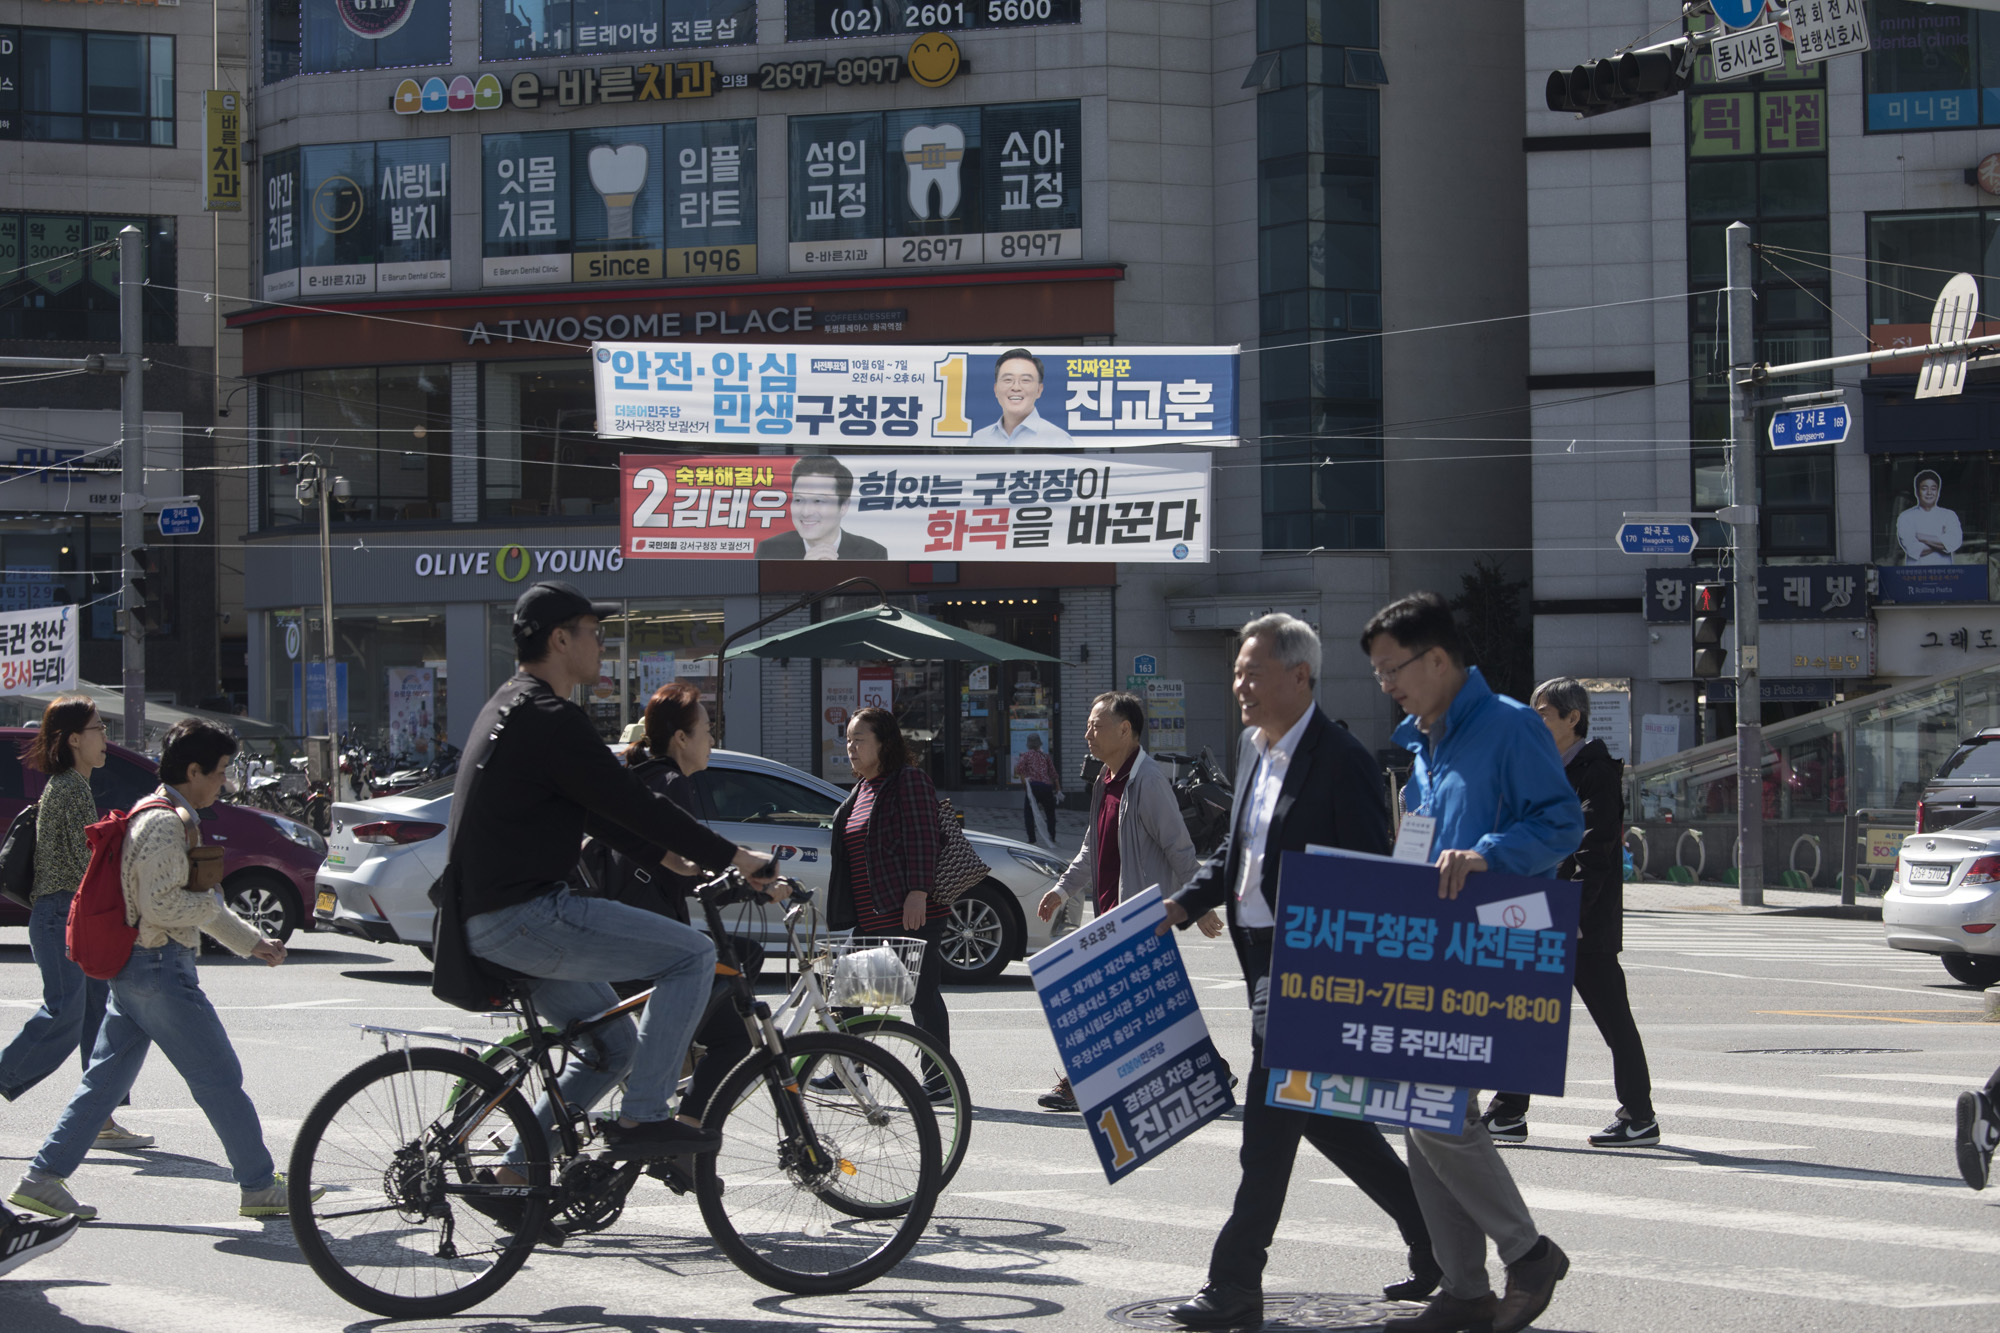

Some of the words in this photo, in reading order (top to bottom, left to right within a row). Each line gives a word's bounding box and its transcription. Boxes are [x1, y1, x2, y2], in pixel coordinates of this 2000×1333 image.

[529, 30, 563, 52] 1:1
[579, 22, 658, 46] 트레이닝
[671, 18, 738, 43] 전문샵
[830, 7, 882, 34] (02)
[905, 3, 964, 28] 2601
[988, 0, 1051, 23] 5600
[0, 39, 14, 55] D
[1716, 33, 1780, 73] 동시신호
[1800, 19, 1864, 54] 보행신호시
[1871, 33, 1921, 50] dental
[1927, 31, 1969, 48] clinic
[0, 77, 14, 91] 스
[510, 60, 716, 109] e-바른치과
[722, 74, 748, 89] 의원
[760, 57, 900, 90] 2697-8997
[1703, 99, 1741, 150] 턱
[1766, 96, 1821, 149] 관절
[1887, 95, 1962, 123] 미니멈
[679, 145, 741, 185] 임플
[805, 139, 866, 178] 성인
[1000, 128, 1065, 168] 소아
[268, 172, 294, 211] 야간
[380, 163, 447, 201] 사랑니
[497, 155, 557, 195] 잇몸
[1000, 172, 1063, 211] 교정
[498, 199, 558, 238] 치료
[679, 190, 742, 229] 란트
[805, 182, 866, 221] 교정
[268, 212, 294, 252] 진료
[390, 204, 437, 241] 발치
[589, 254, 650, 278] since
[682, 249, 741, 274] 1996
[805, 249, 868, 263] e-바른치과
[902, 238, 963, 263] 2697
[1000, 233, 1063, 259] 8997
[308, 274, 367, 287] e-바른치과
[381, 274, 387, 282] E
[388, 273, 407, 282] Barun
[408, 272, 428, 281] Dental
[429, 271, 446, 280] Clinic
[493, 268, 499, 277] E
[500, 266, 519, 276] Barun
[520, 265, 541, 275] Dental
[541, 264, 560, 274] Clinic
[467, 321, 491, 345] A
[499, 312, 681, 344] TWOSOME
[695, 306, 813, 336] PLACE
[872, 321, 903, 332] 화곡역점
[611, 350, 797, 394] 안전·안심
[812, 360, 848, 372] 사전투표일
[851, 359, 870, 371] 10월
[871, 360, 886, 371] 6일
[894, 359, 908, 371] 7일
[851, 372, 868, 384] 오전
[869, 372, 884, 384] 6시
[893, 372, 910, 384] 오후
[911, 373, 926, 384] 6시
[1066, 358, 1132, 378] 진짜일꾼
[614, 404, 682, 418] 더불어민주당
[931, 352, 973, 438] 1
[1065, 379, 1214, 431] 진교훈
[614, 419, 667, 433] 강서구청장
[667, 419, 710, 434] 보궐선거
[713, 393, 923, 437] 민생구청장
[1774, 424, 1786, 434] 165
[1794, 411, 1827, 431] 강서로
[1833, 416, 1845, 428] 169
[1794, 431, 1826, 442] Gangseo-ro
[675, 465, 774, 487] 숙원해결사
[858, 469, 963, 512] 힘있는
[973, 467, 1110, 505] 구청장이
[632, 467, 669, 529] 2
[672, 488, 788, 529] 김태우
[924, 506, 1053, 553] 화곡을
[1066, 498, 1201, 547] 바꾼다
[1625, 535, 1637, 543] 170
[1643, 526, 1671, 536] 화곡로
[1677, 535, 1690, 543] 166
[1642, 537, 1674, 546] Hwagok-ro
[415, 552, 490, 577] OLIVE
[535, 549, 624, 573] YOUNG
[647, 540, 677, 550] 국민의힘
[679, 540, 718, 551] 강서구청장
[719, 540, 750, 551] 보궐선거
[1654, 575, 1857, 612] 황래방
[1915, 586, 1935, 594] Rolling
[30, 619, 65, 654] 청산
[1919, 627, 1997, 653] 그래도
[2, 656, 65, 690] 강서부터!
[1139, 664, 1152, 673] 163
[1793, 654, 1861, 671] 화수빌딩
[1773, 684, 1804, 696] Pasta
[1928, 867, 1947, 880] 5702
[1079, 920, 1117, 951] 주요공약
[1284, 905, 1439, 962] 강서구청장
[1444, 920, 1568, 974] 사전투표
[1050, 989, 1072, 1009] 빠른
[1136, 935, 1161, 959] 추진!
[1057, 993, 1108, 1030] 대장홍대선
[1108, 979, 1130, 999] 조기
[1129, 965, 1152, 984] 착공
[1152, 949, 1177, 973] 추진!
[1065, 999, 1133, 1050] 서울시립도서관
[1133, 986, 1156, 1007] 조기
[1155, 971, 1181, 993] 착공!
[1441, 988, 1562, 1025] 6:00~18:00
[1071, 1037, 1113, 1070] 우장산역
[1113, 1020, 1144, 1046] 출입구
[1144, 1005, 1167, 1026] 신설
[1166, 989, 1191, 1012] 추진!
[1341, 1022, 1367, 1051] 각
[1370, 1025, 1395, 1054] 동
[1400, 1028, 1493, 1064] 주민센터
[1117, 1041, 1166, 1078] 더불어민주당
[1123, 1077, 1164, 1115] 경찰청
[1165, 1058, 1195, 1088] 차장
[1129, 1068, 1227, 1155] 진교훈
[1097, 1105, 1139, 1173] 1
